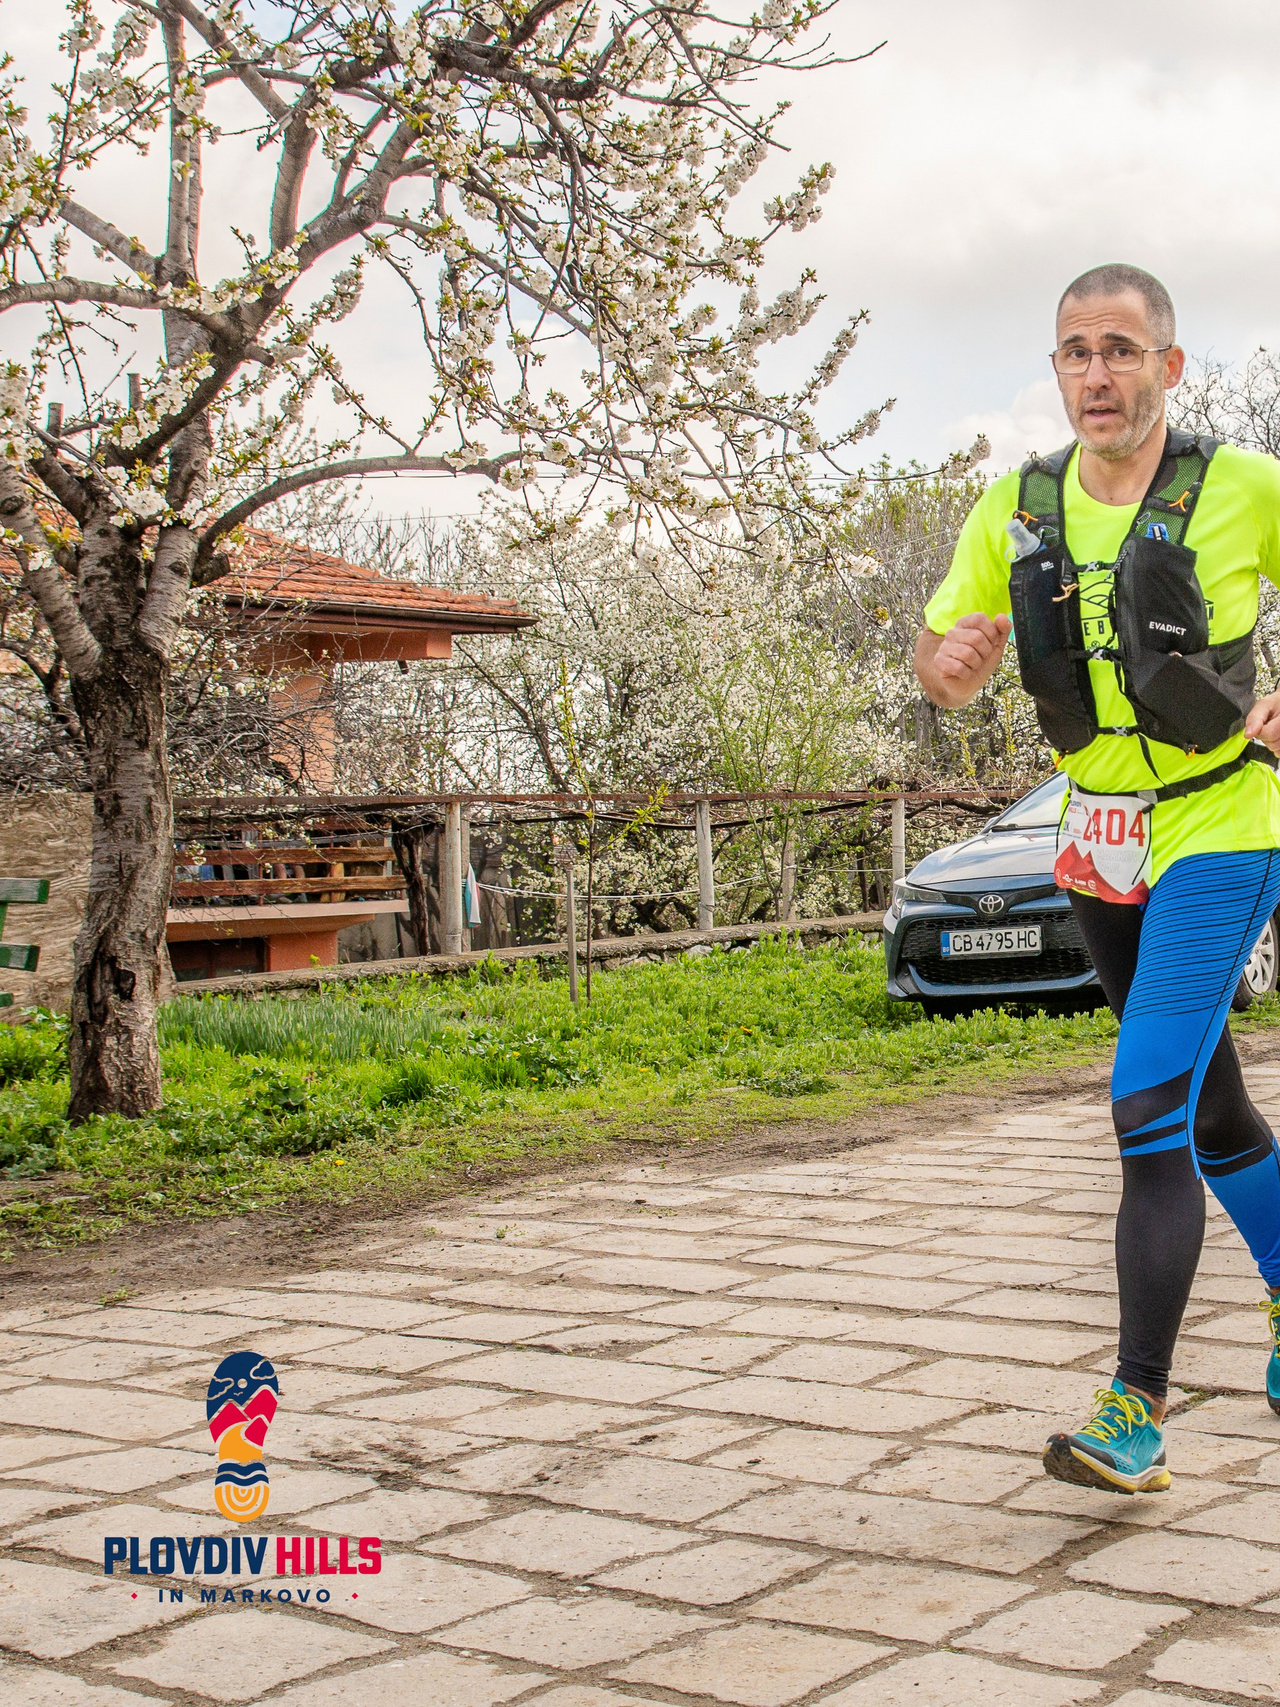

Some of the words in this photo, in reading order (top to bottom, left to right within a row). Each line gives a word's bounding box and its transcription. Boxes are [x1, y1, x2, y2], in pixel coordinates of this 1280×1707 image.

[1149, 621, 1187, 636] EVADICT
[1083, 806, 1146, 847] 2404
[952, 934, 973, 952] CB
[975, 932, 1014, 951] 4795
[1017, 930, 1037, 949] HC
